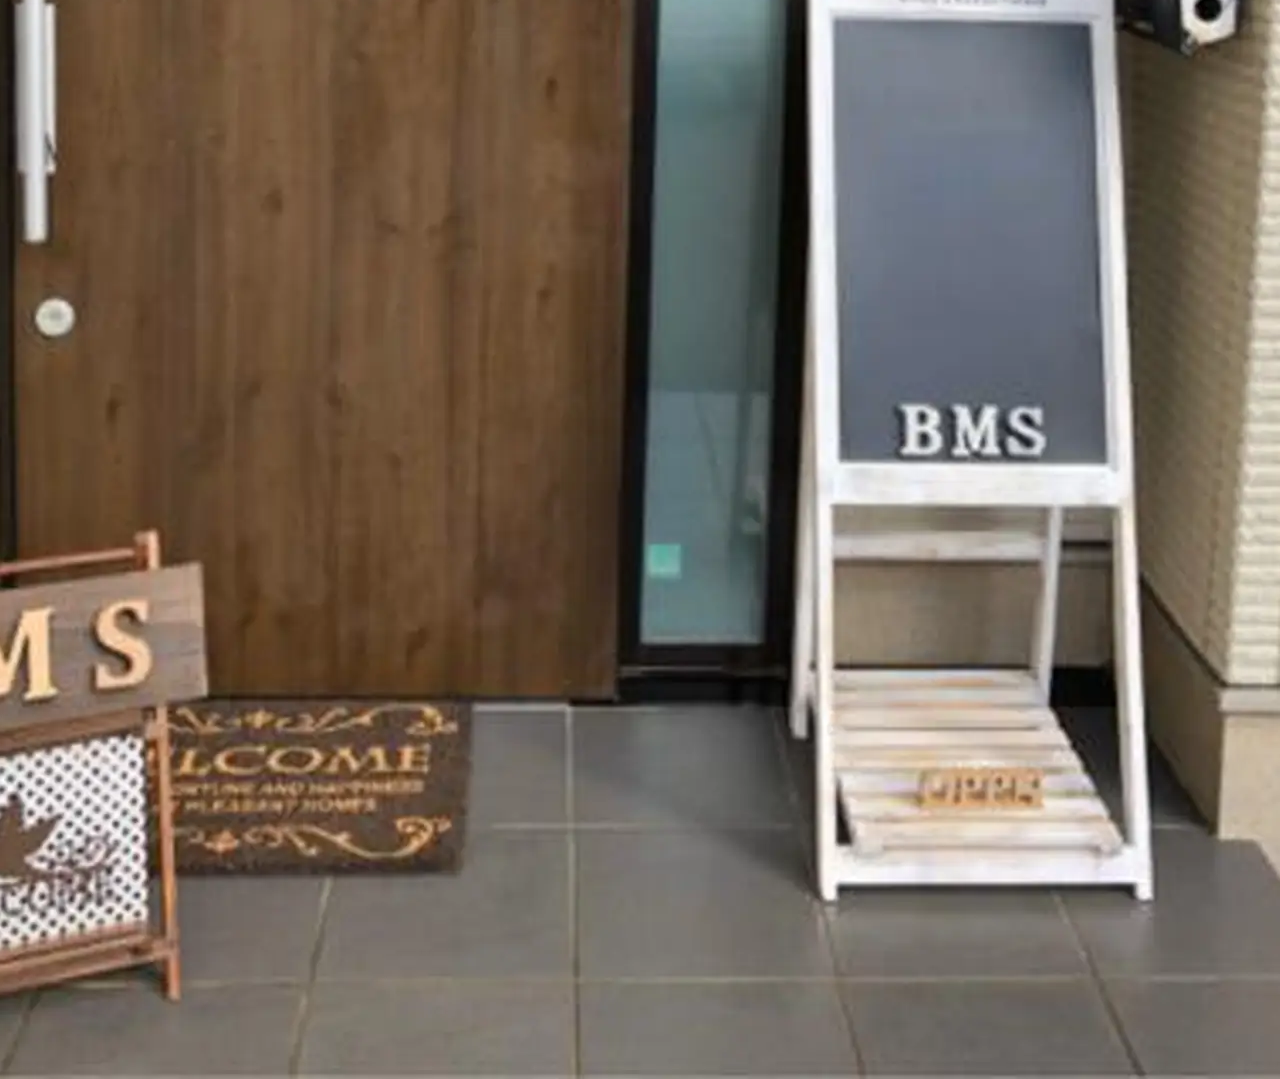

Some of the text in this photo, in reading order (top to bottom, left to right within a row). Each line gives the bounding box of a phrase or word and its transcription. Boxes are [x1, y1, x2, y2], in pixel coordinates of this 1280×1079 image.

[899, 402, 1047, 457] BMS
[259, 781, 307, 796] AND
[309, 778, 425, 795] HAPPINESS
